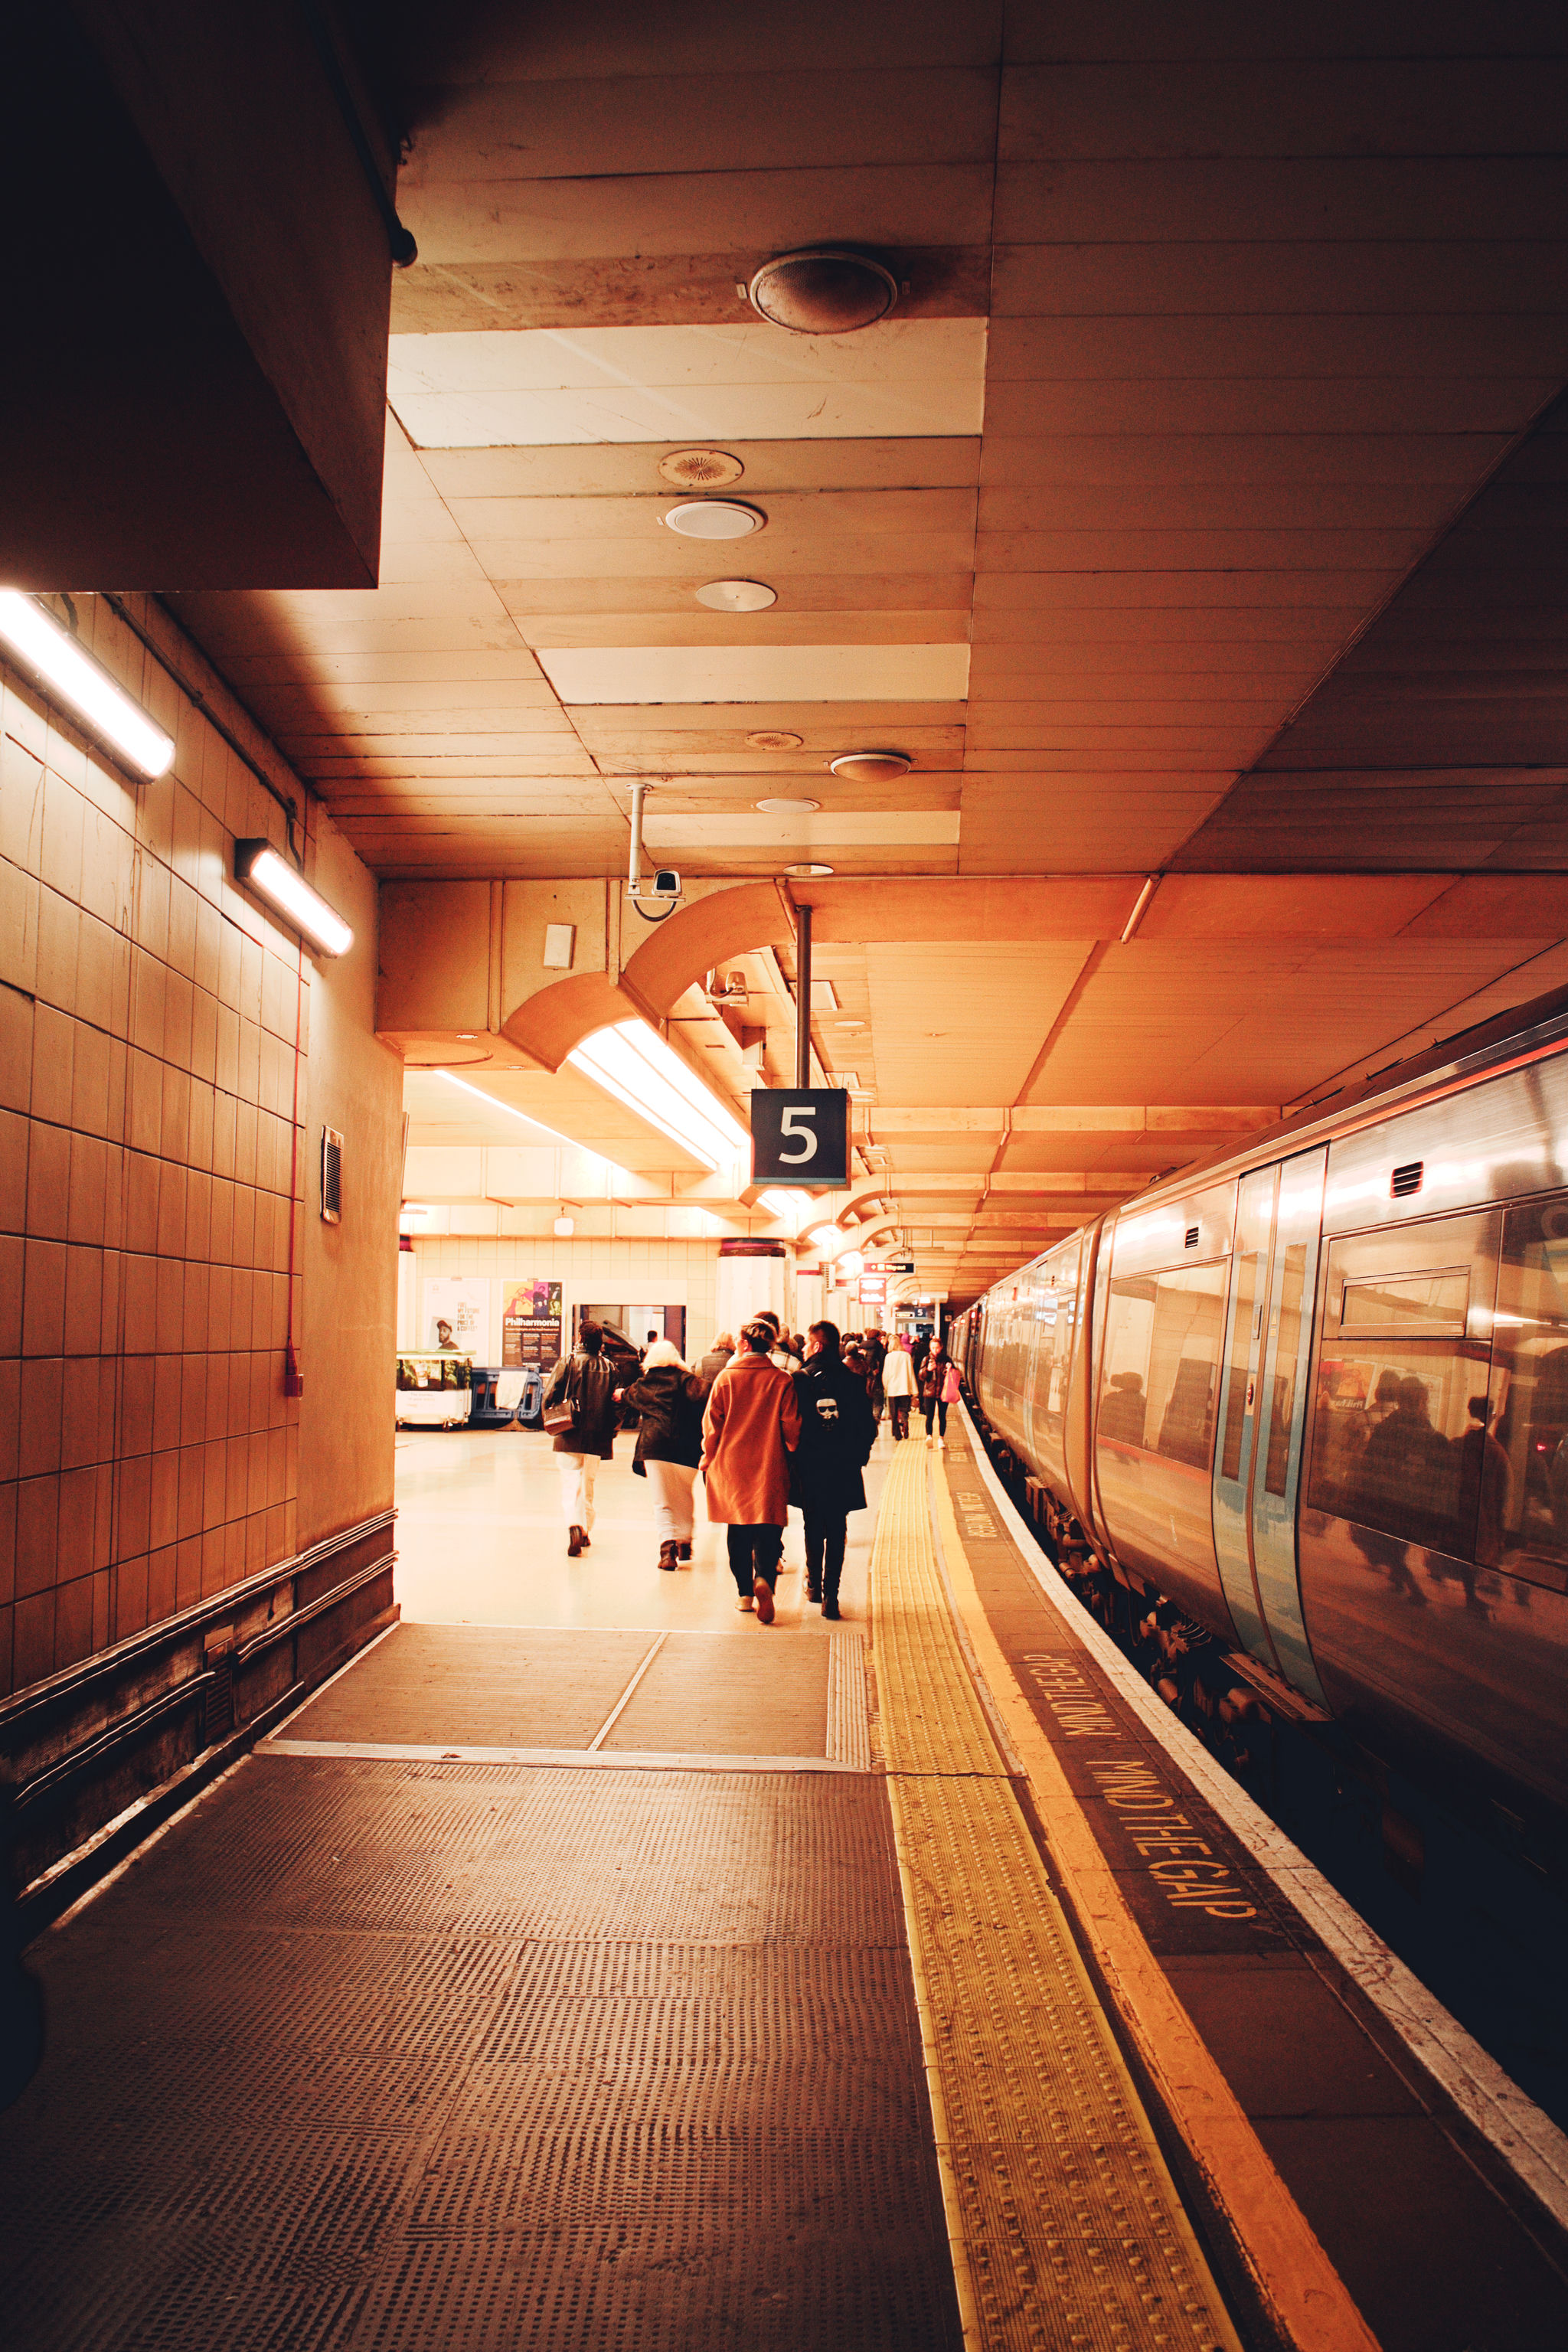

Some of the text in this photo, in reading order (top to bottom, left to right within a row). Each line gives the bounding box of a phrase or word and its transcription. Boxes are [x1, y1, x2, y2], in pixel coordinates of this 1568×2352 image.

[778, 1106, 818, 1165] 5
[505, 1317, 560, 1327] Philharmonia
[1023, 1655, 1122, 1736] MIND THE GAP
[1085, 1760, 1258, 1918] MIND THE GAP
